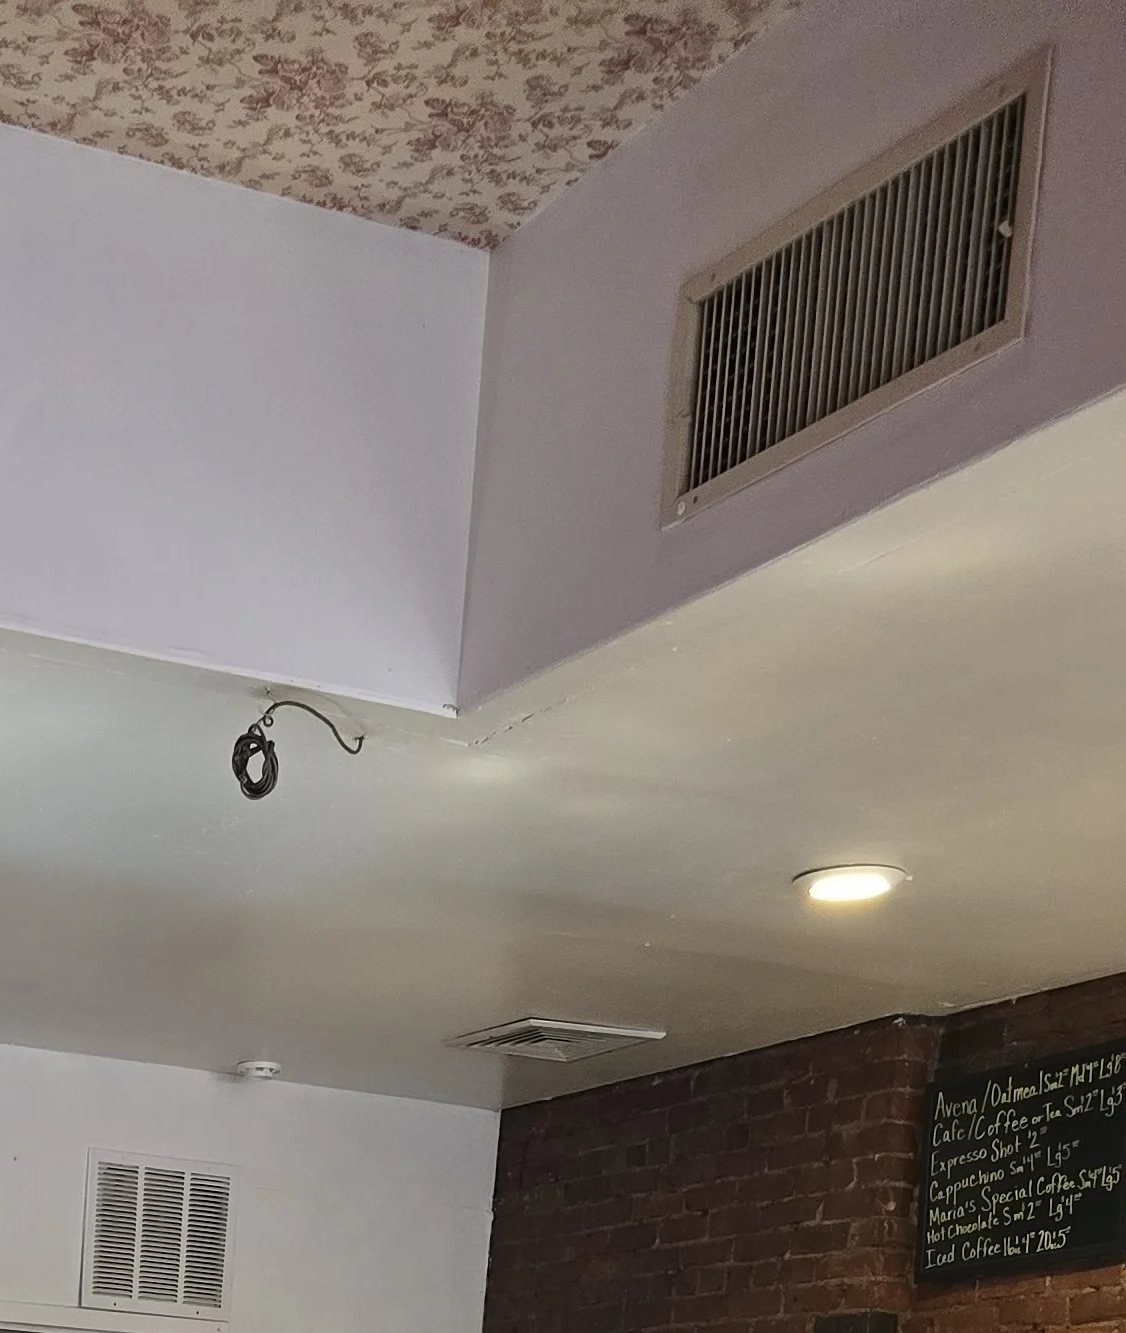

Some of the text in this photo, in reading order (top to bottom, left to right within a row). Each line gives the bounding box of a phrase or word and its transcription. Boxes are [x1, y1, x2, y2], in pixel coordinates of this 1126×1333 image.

[1042, 1102, 1063, 1122] Tea
[930, 1148, 987, 1180] Expresso
[990, 1134, 1022, 1163] Shot
[929, 1200, 977, 1227] Maria's
[980, 1178, 1033, 1216] Special
[1036, 1172, 1076, 1196] Coffee
[927, 1226, 946, 1245] Hot
[947, 1211, 1000, 1239] Chocolate
[925, 1243, 955, 1269] Iced
[961, 1236, 1001, 1261] Coffee
